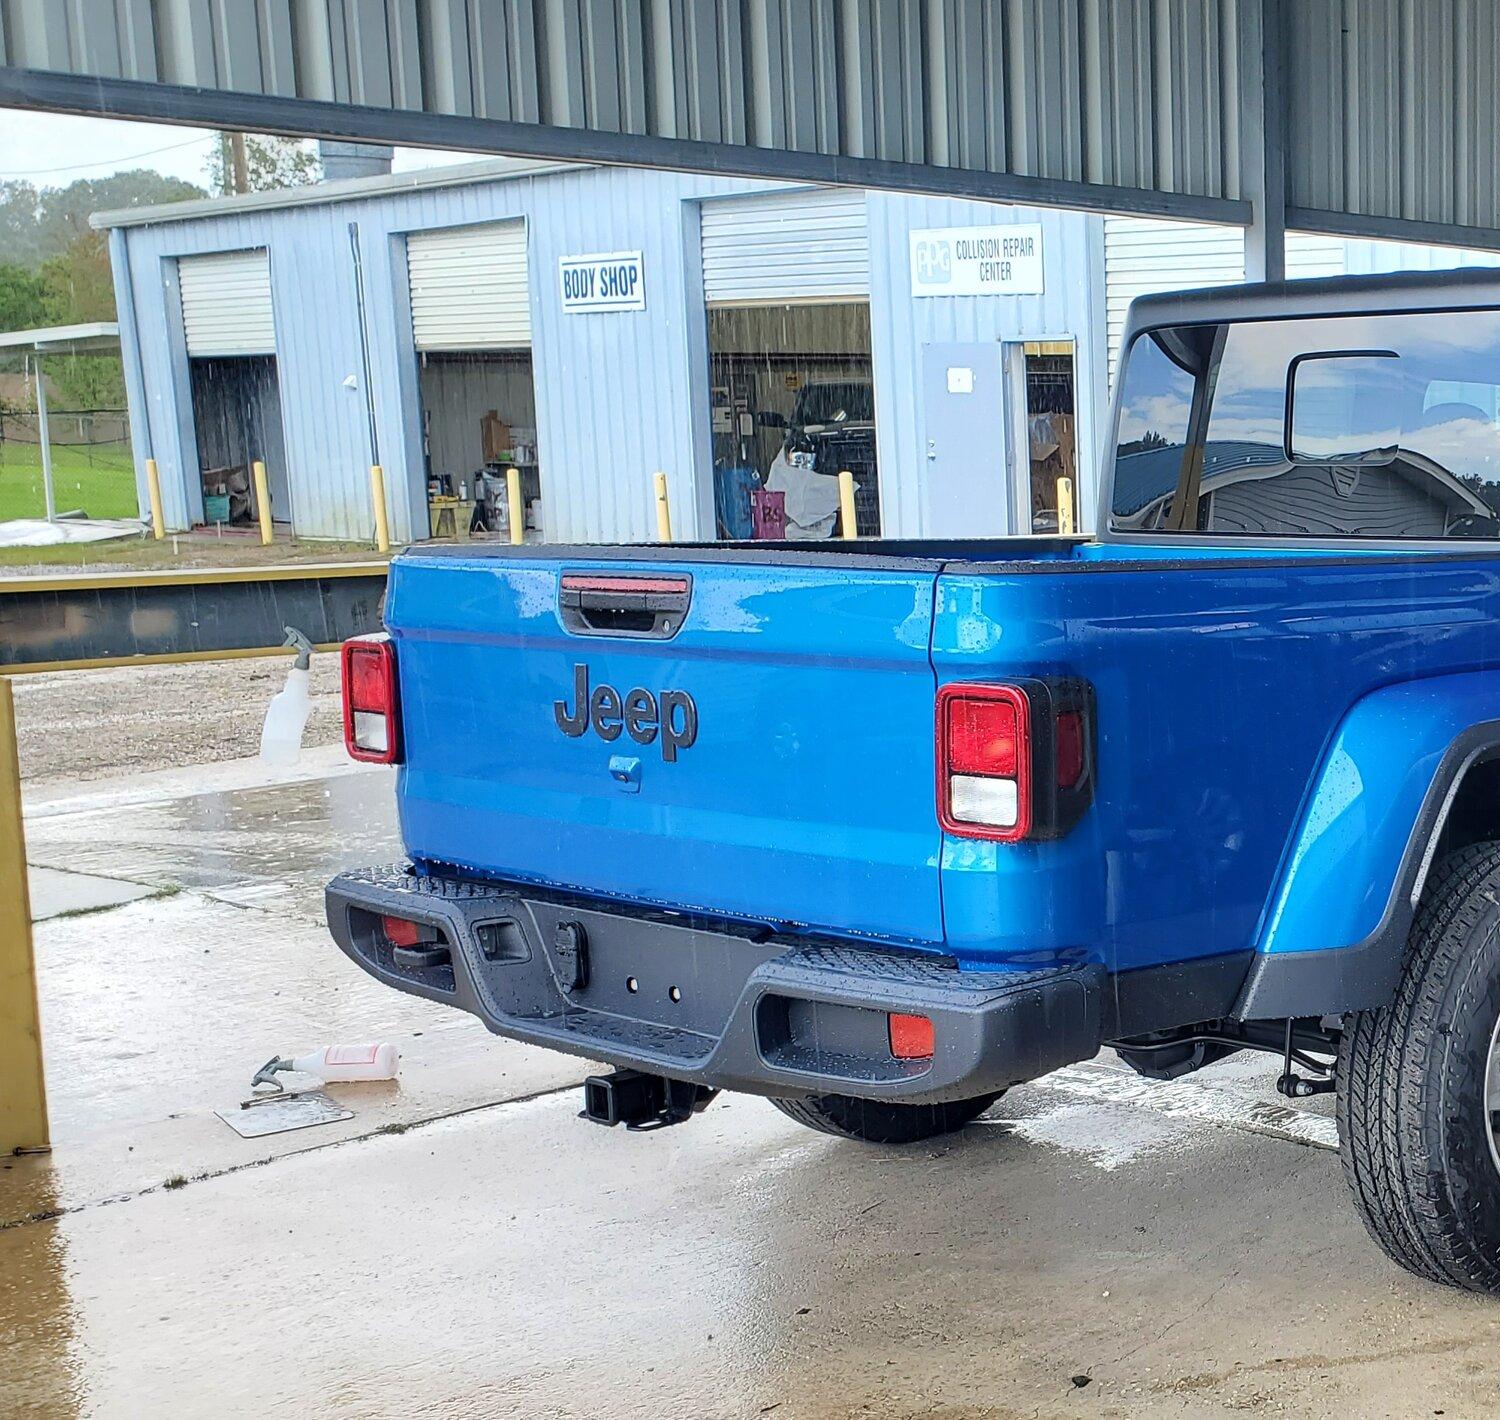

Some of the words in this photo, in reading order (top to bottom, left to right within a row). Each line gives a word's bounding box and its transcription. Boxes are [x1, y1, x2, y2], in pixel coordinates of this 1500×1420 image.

[956, 238, 1000, 260] COLLISION
[1003, 237, 1034, 258] REPAIR
[563, 268, 595, 299] BODY
[600, 265, 637, 297] SHOP
[980, 261, 1011, 281] CENTER
[554, 663, 698, 762] Jeep
